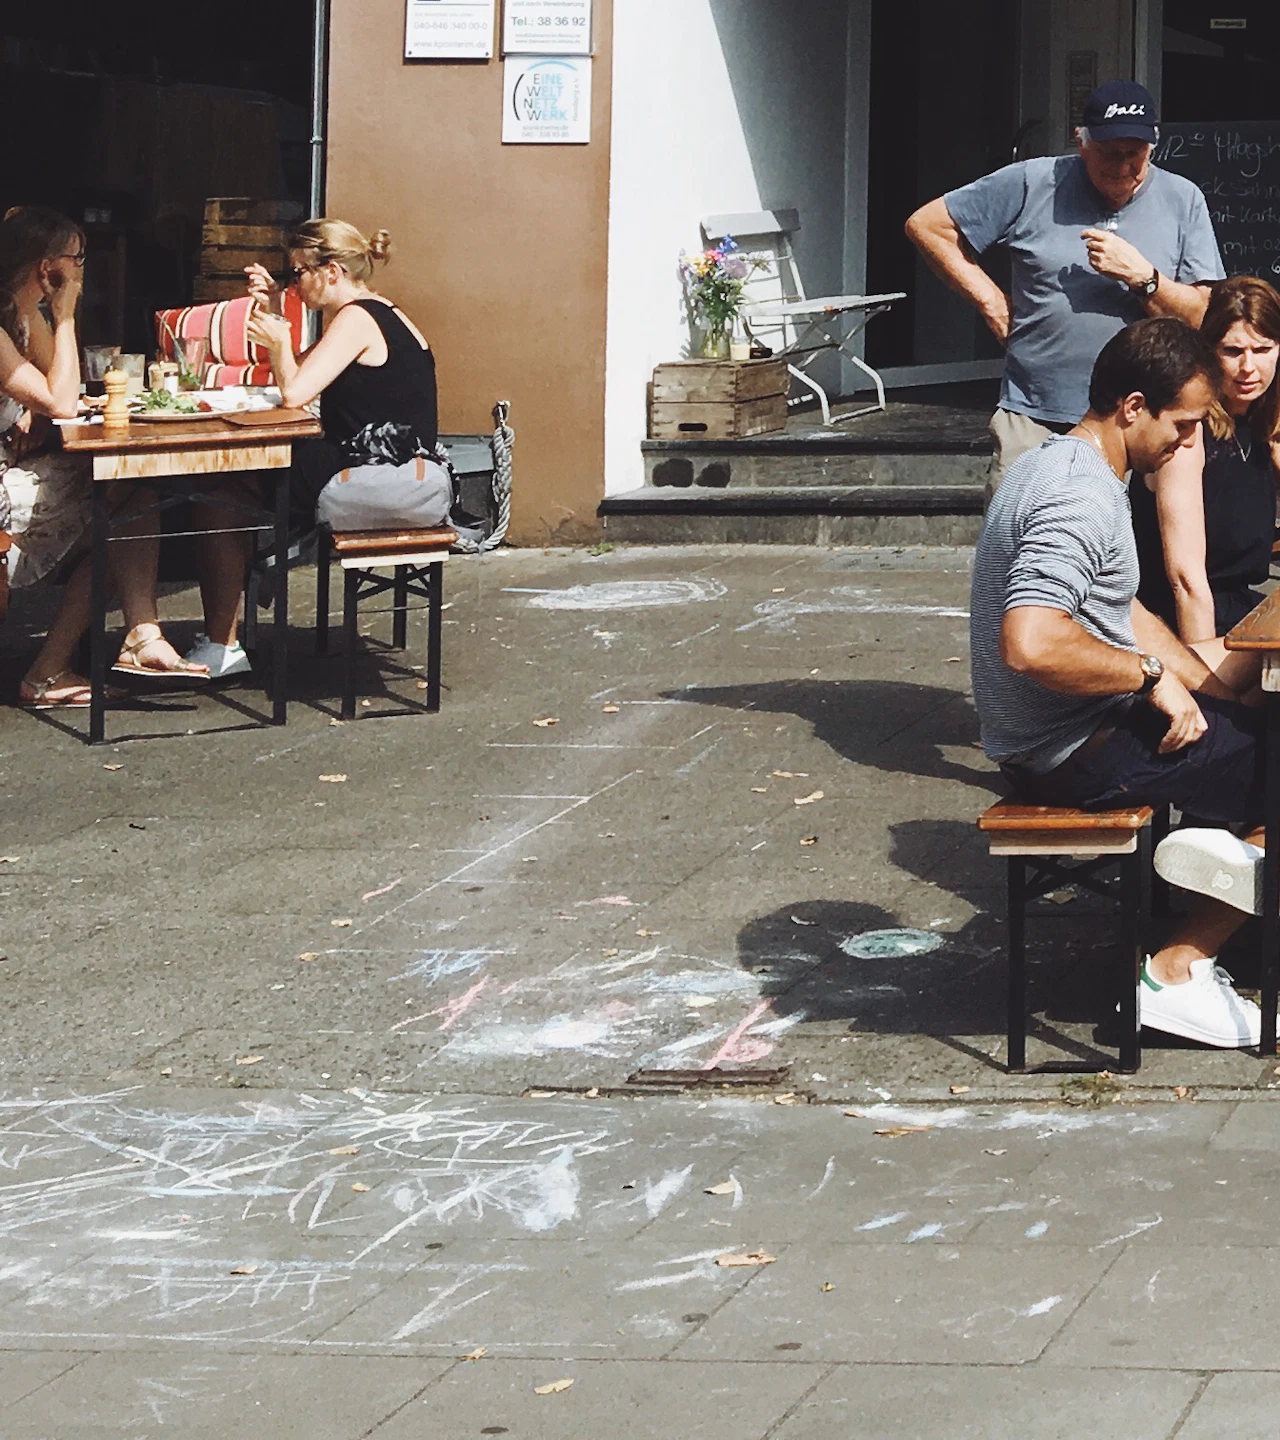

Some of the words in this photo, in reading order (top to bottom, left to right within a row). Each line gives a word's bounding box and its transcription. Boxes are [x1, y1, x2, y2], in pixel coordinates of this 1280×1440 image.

[537, 16, 552, 26] 38
[554, 16, 569, 26] 36
[572, 16, 587, 26] 92
[533, 73, 563, 85] EINE
[526, 86, 564, 97] WELT
[523, 98, 558, 109] NETZ
[526, 110, 568, 121] WERK
[1104, 103, 1145, 118] Bali
